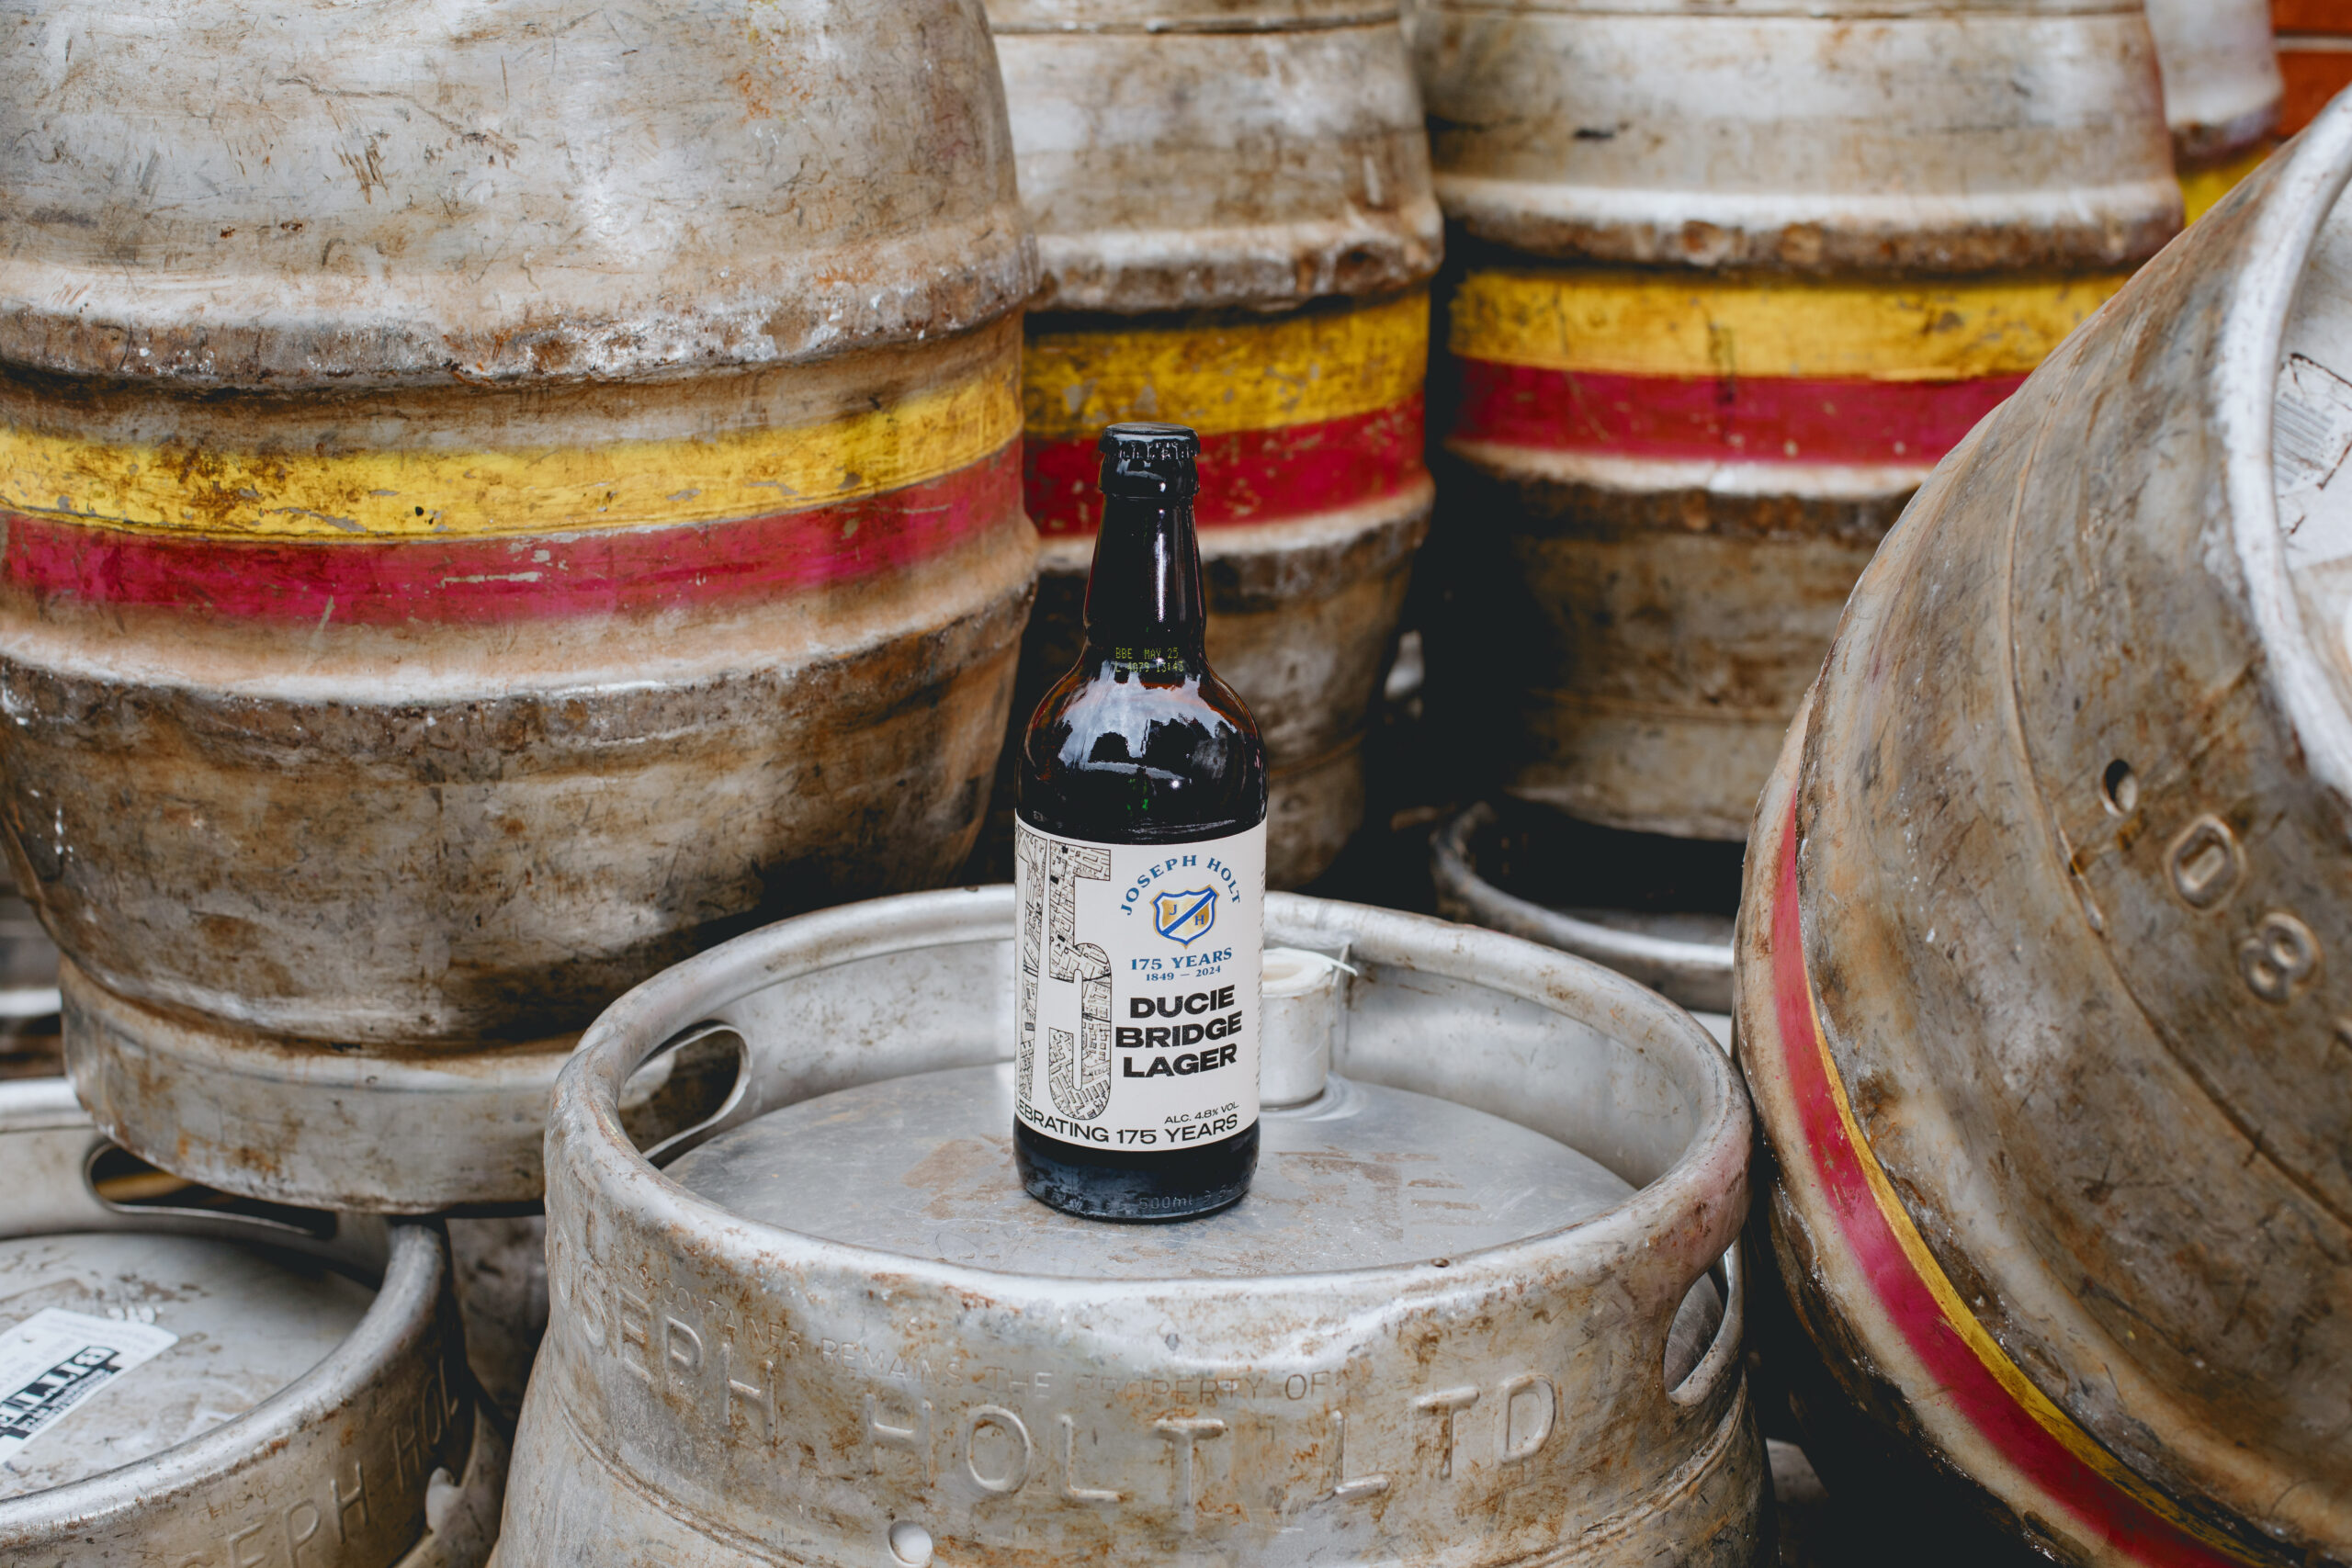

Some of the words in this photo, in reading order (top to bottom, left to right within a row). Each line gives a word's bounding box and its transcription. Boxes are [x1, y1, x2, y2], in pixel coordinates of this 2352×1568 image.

[1115, 647, 1133, 660] BBE
[1144, 648, 1161, 660] MAY
[1167, 647, 1179, 660] 25
[1121, 854, 1197, 916] JOSEPH
[1206, 857, 1240, 905] HOLT
[1168, 904, 1178, 916] J
[1194, 914, 1205, 926] H
[1131, 958, 1162, 970] 175
[1171, 947, 1232, 969] YEARS
[1146, 972, 1174, 981] 1849
[1195, 965, 1221, 977] 2024
[1130, 985, 1235, 1018] DUCIE
[1115, 1010, 1242, 1048] BRIDGE
[1124, 1043, 1238, 1077] LAGER
[1116, 1129, 1157, 1145] 175
[1165, 1113, 1238, 1143] YEARS
[1164, 1112, 1192, 1124] ALC.
[1194, 1109, 1218, 1120] 4.8%
[983, 1365, 1053, 1399] THE
[1076, 1375, 1263, 1407] PROPERTY
[1285, 1370, 1330, 1401] OF
[864, 1392, 1227, 1507] HOLT
[1329, 1374, 1558, 1500] LTD
